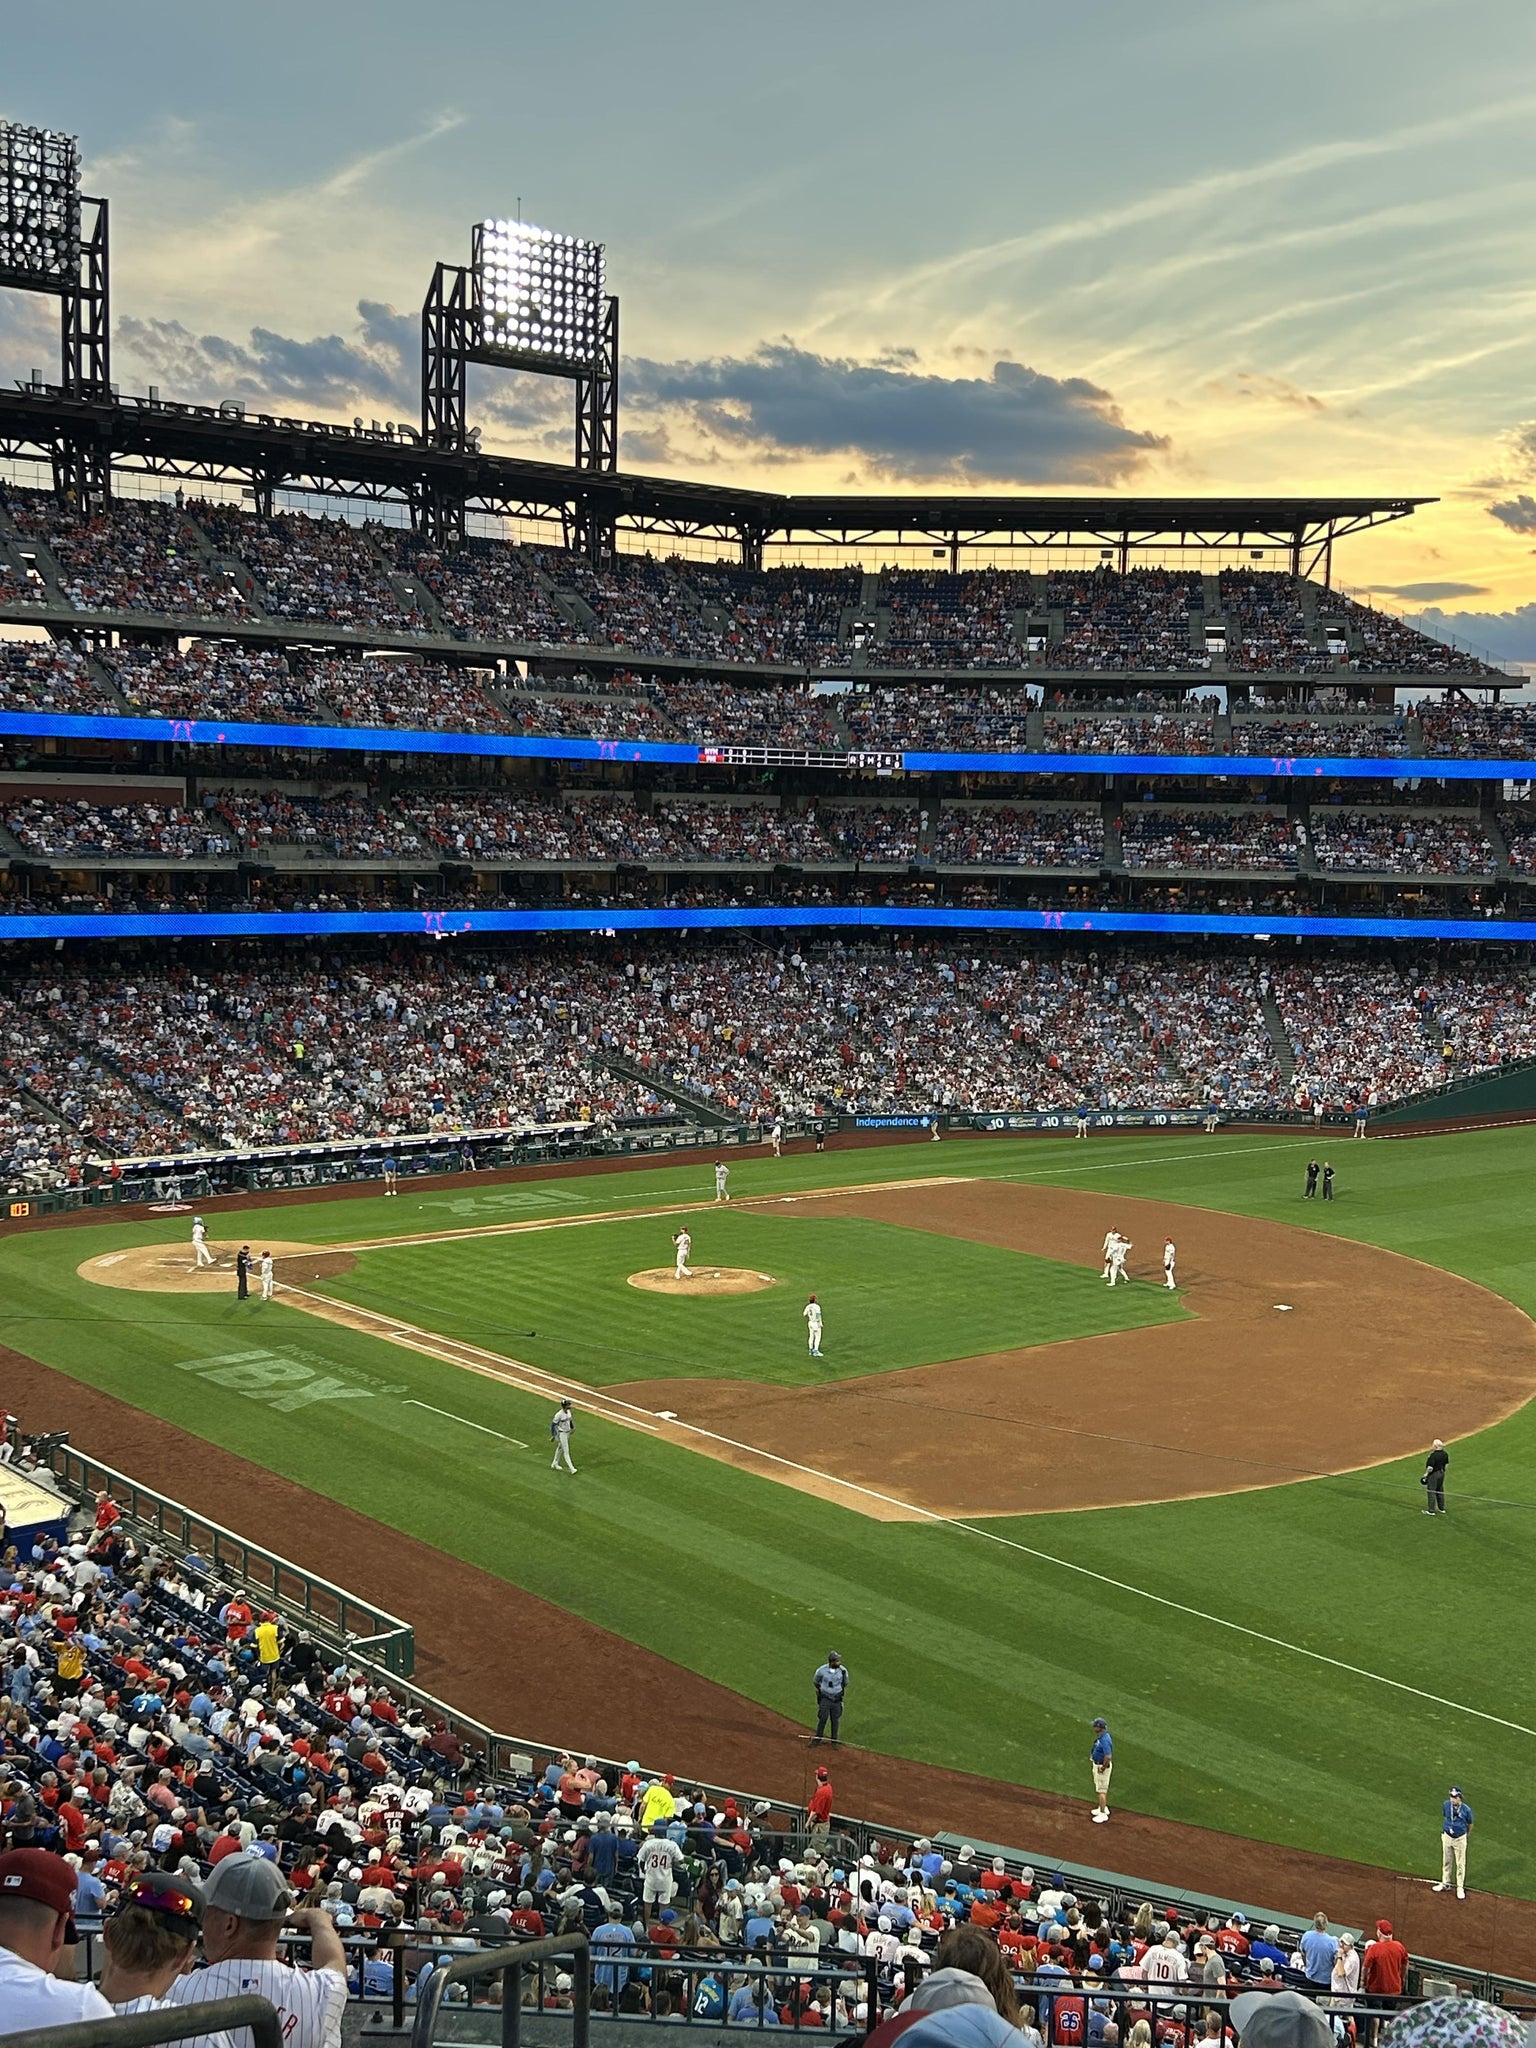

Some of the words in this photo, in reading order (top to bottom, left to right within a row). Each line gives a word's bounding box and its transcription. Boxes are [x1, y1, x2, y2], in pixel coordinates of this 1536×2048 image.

[850, 755, 857, 765] R
[867, 755, 875, 765] H
[856, 1116, 919, 1128] Independence
[990, 1117, 1005, 1130] 10
[1046, 1116, 1059, 1127] 10
[1101, 1115, 1114, 1126] 10
[1155, 1114, 1168, 1125] 10
[275, 1344, 387, 1387] Independence
[173, 1349, 377, 1414] IBX
[136, 1699, 148, 1713] 3
[651, 1854, 668, 1869] 34
[874, 1945, 884, 1960] 3
[1156, 1962, 1169, 1980] 10
[694, 1991, 709, 2015] 12
